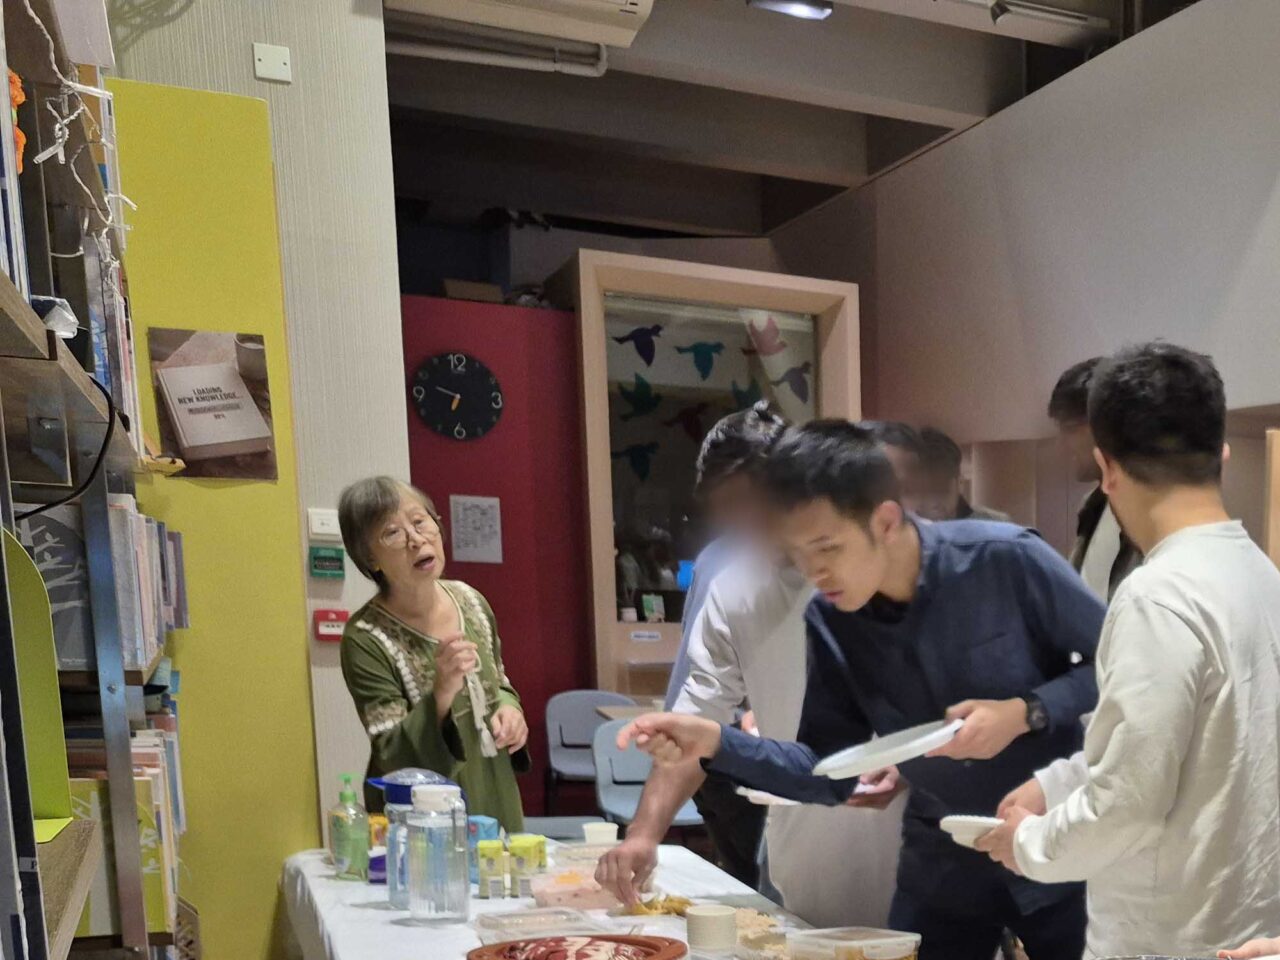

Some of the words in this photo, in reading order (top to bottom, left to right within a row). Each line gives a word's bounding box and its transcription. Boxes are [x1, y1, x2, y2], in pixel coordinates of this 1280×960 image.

[447, 353, 467, 373] 12
[193, 386, 223, 396] LOADING
[412, 386, 425, 402] 9
[178, 395, 194, 405] NEW
[490, 391, 503, 409] 3
[453, 422, 466, 439] 6
